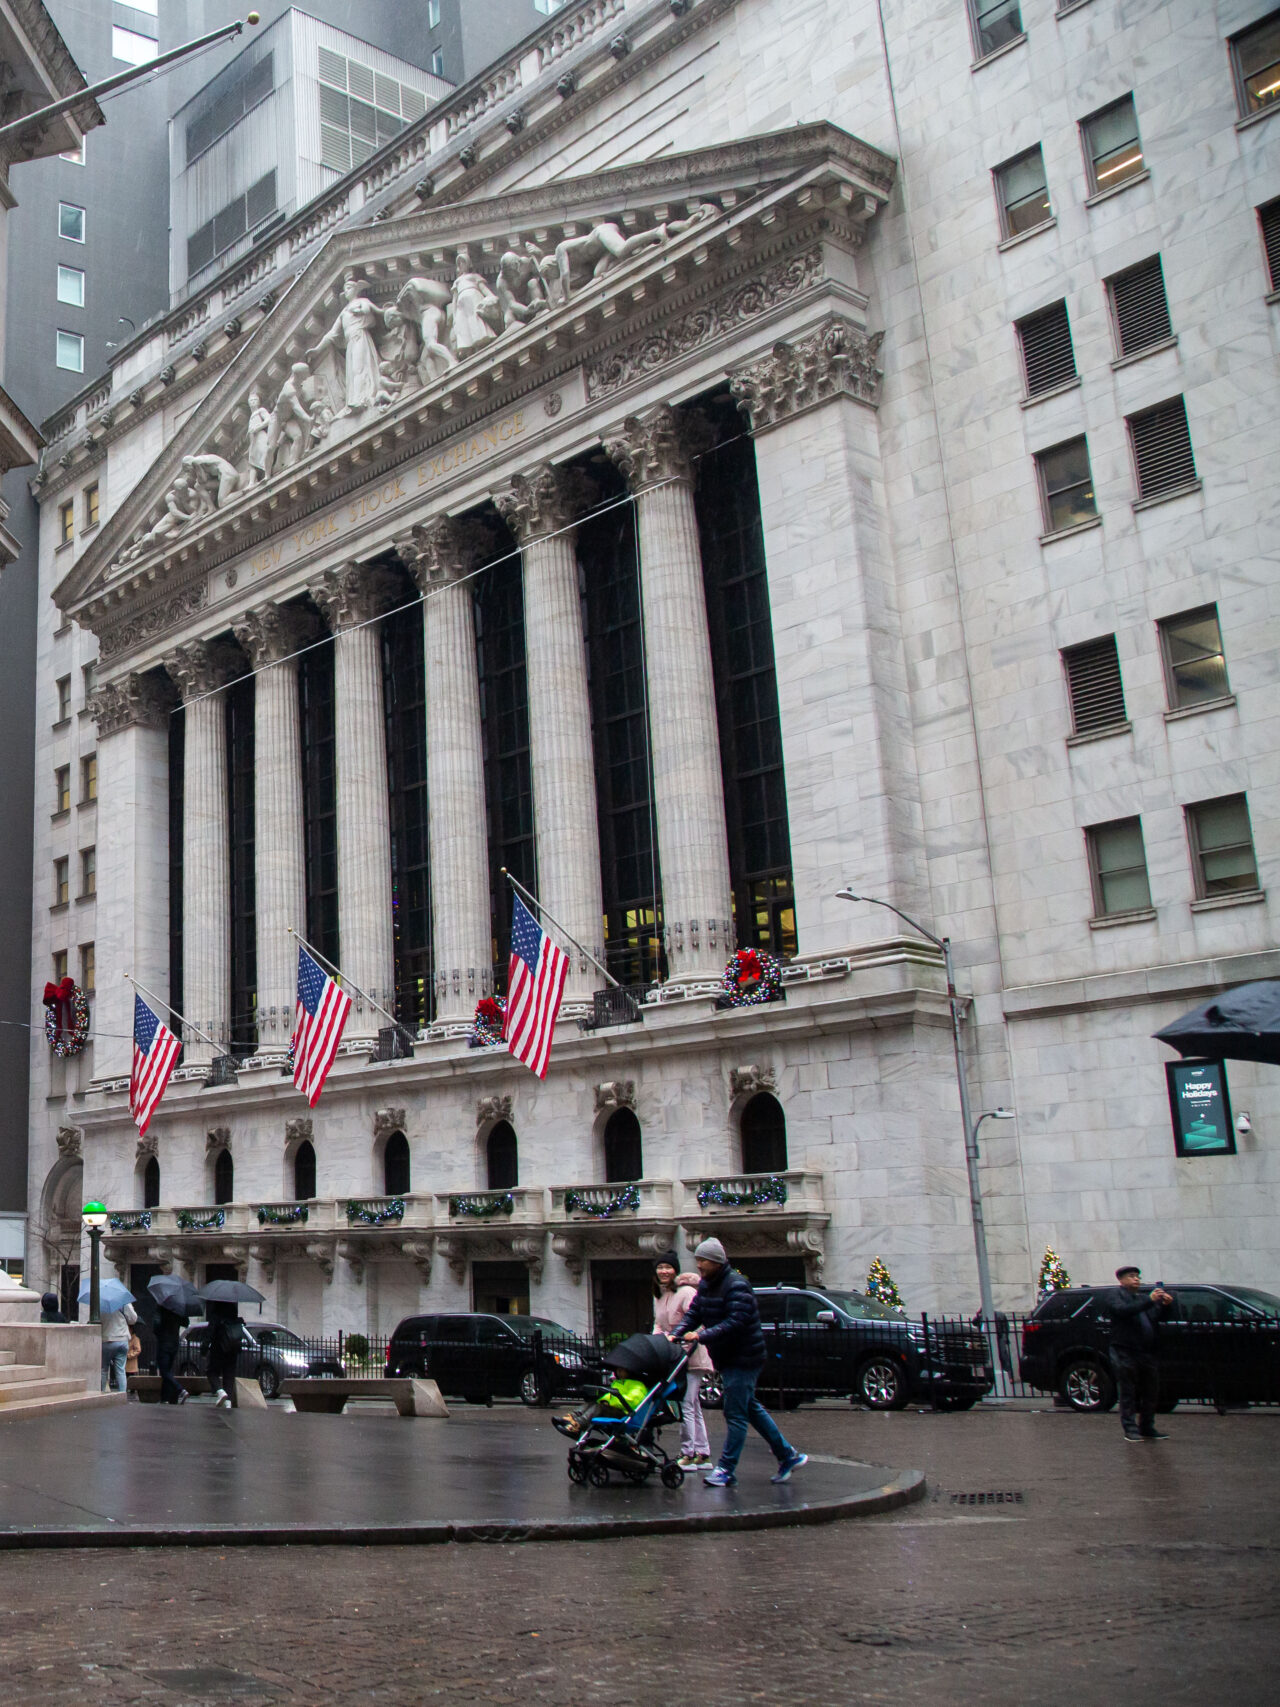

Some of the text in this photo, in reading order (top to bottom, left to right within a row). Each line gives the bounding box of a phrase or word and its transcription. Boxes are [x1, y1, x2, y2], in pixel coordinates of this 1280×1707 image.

[249, 413, 526, 577] NEW YORK STOCK EXCHANGE
[1185, 1082, 1212, 1090] Happy
[1182, 1090, 1218, 1098] Holidays
